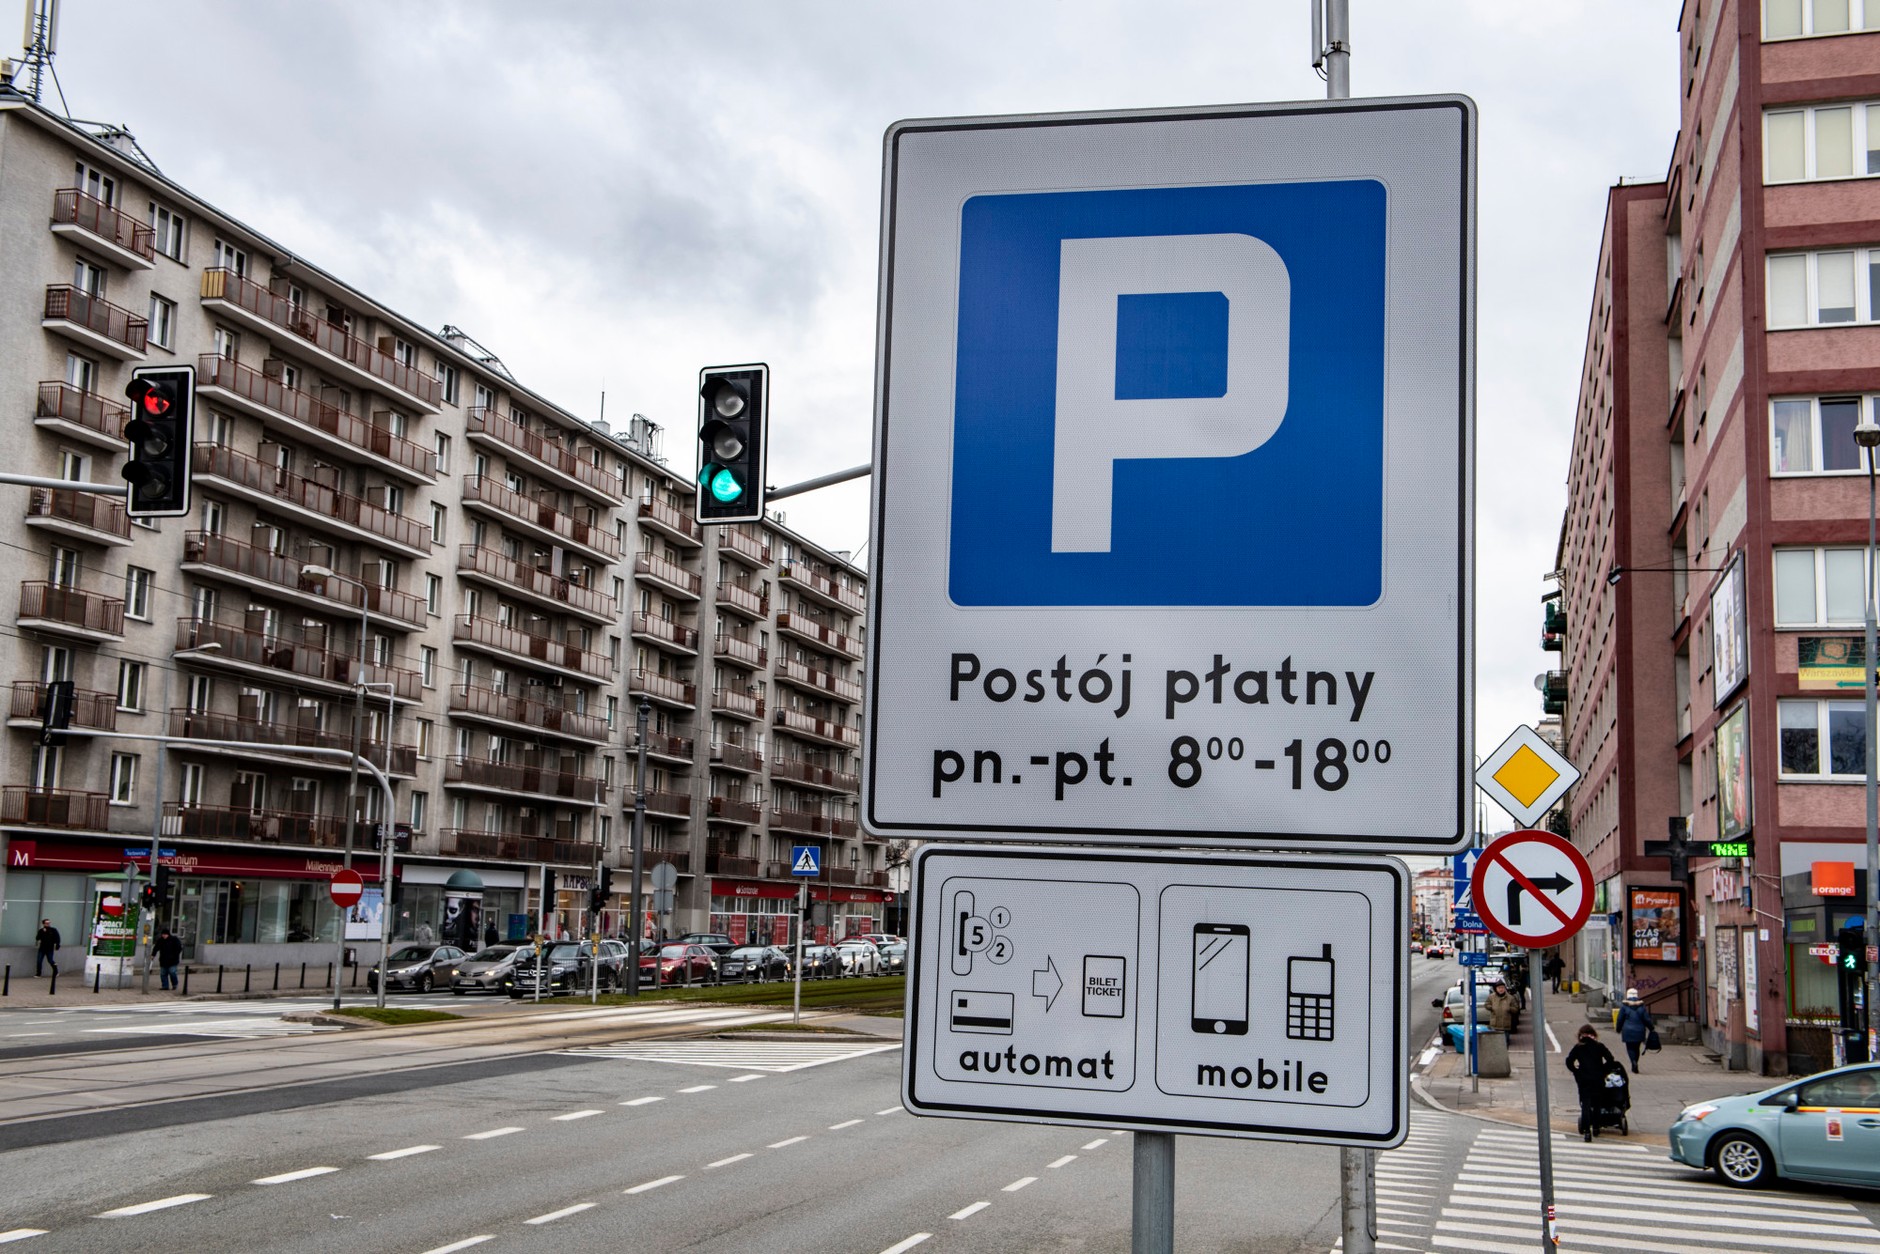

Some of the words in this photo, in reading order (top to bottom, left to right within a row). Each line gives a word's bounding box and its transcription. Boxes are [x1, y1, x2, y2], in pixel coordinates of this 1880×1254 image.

[1051, 232, 1291, 553] P
[949, 652, 1132, 719] Postój
[1165, 654, 1375, 722] płatny
[932, 737, 1133, 801] pn.-pt.
[14, 850, 29, 866] M
[306, 859, 344, 872] Millennium
[1818, 886, 1852, 896] orange
[997, 912, 1003, 924] 1
[1462, 920, 1483, 929] Dolna
[971, 925, 984, 946] 5
[1634, 929, 1659, 937] CZAS
[995, 942, 1005, 958] 2
[1634, 939, 1649, 947] NA
[1088, 977, 1118, 986] BILET
[1086, 987, 1122, 997] TICKET
[959, 1045, 1114, 1080] automat
[1197, 1057, 1328, 1094] mobile
